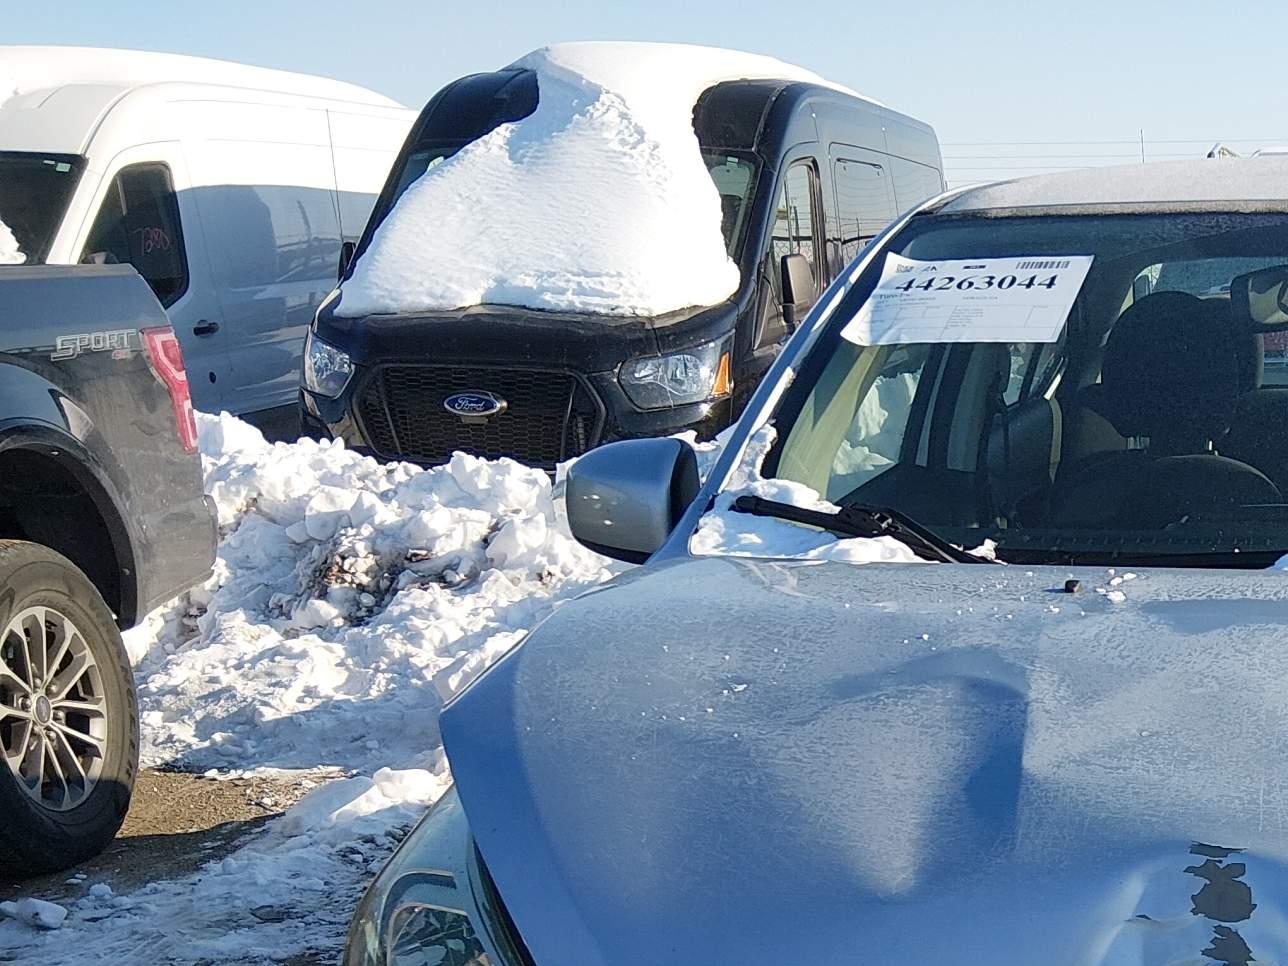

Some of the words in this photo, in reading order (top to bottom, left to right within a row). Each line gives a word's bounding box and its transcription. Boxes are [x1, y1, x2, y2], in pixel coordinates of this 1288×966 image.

[895, 275, 1058, 292] 44263044
[51, 329, 137, 361] SPORT
[454, 397, 486, 411] Ford
